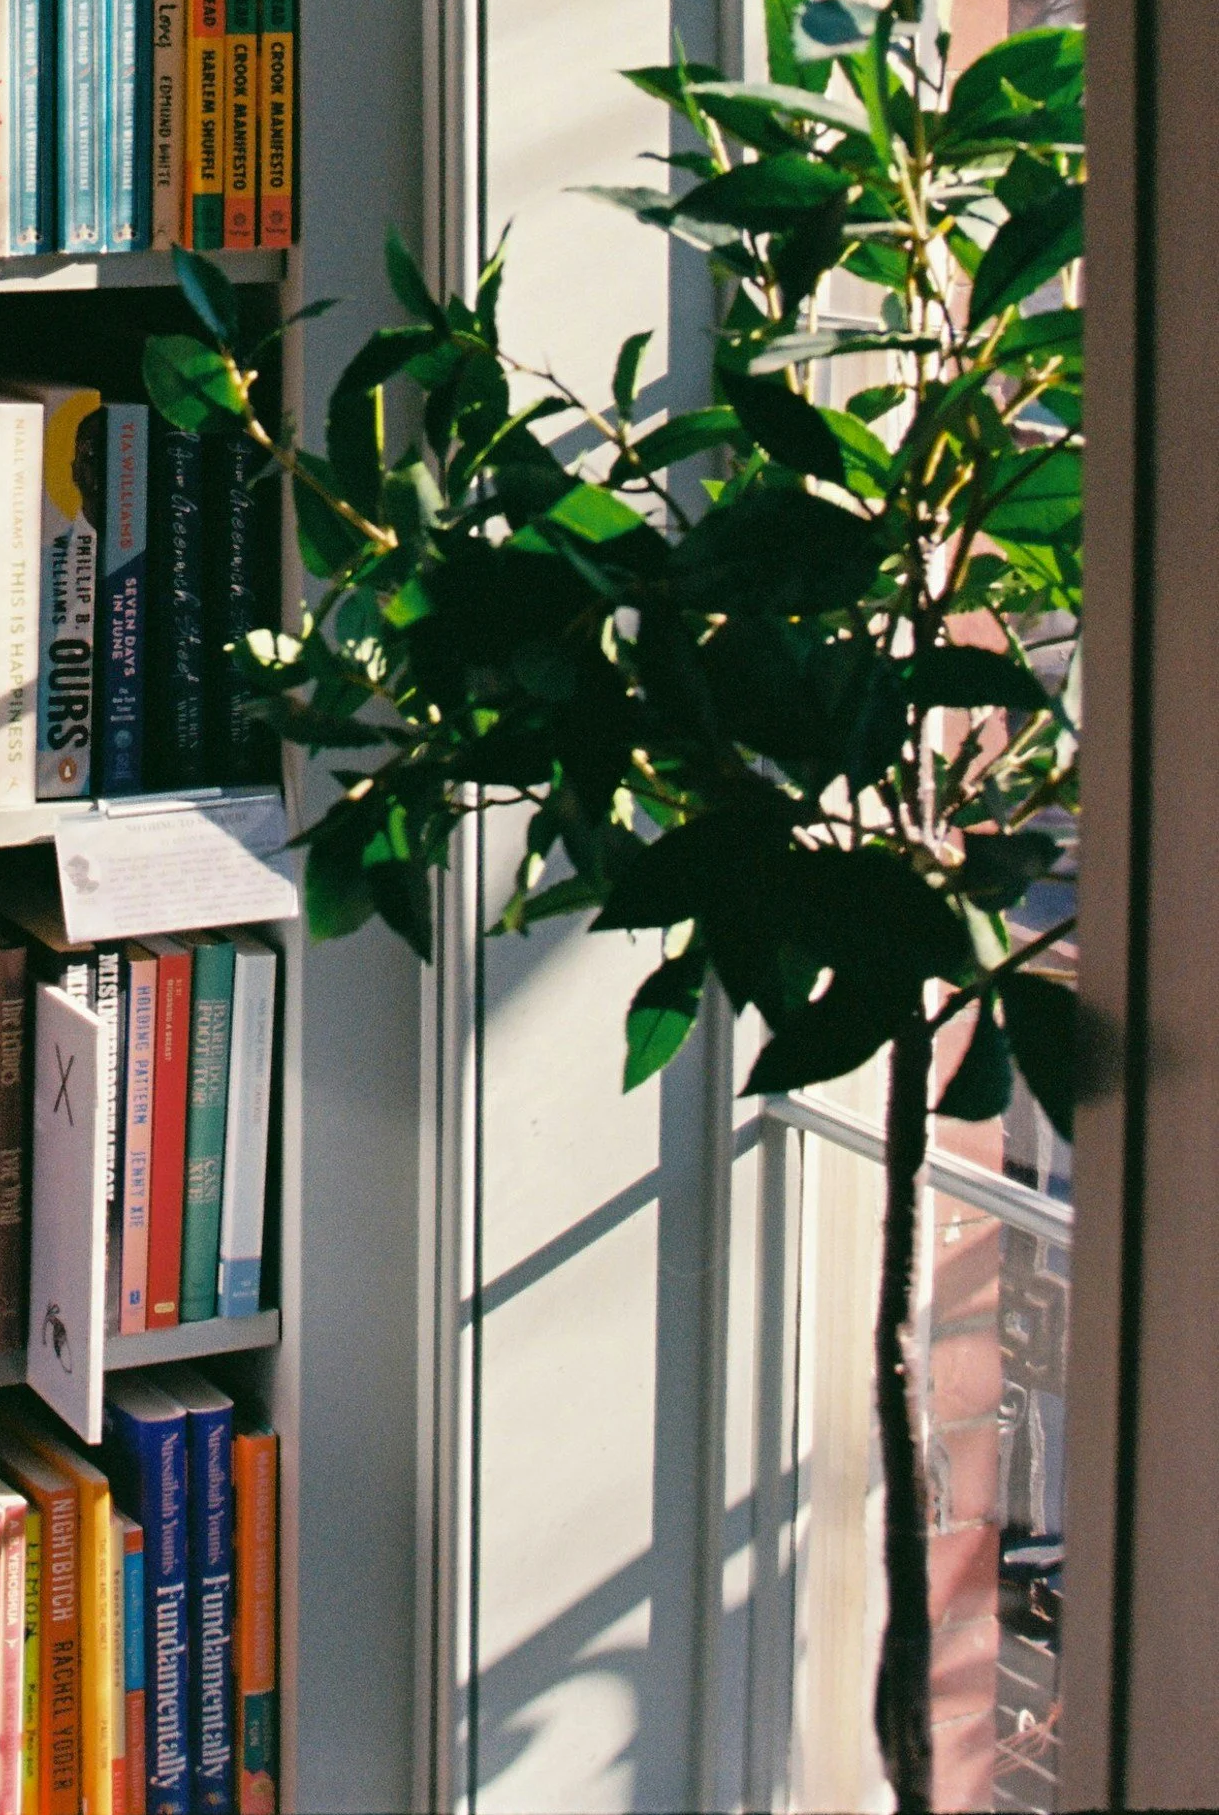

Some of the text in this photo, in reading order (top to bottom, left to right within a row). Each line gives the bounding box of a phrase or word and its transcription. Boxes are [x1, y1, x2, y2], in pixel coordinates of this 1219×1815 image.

[200, 50, 217, 114] HARLEM
[201, 119, 217, 180] SHUFFLE
[52, 536, 67, 625] WILLIAMS
[74, 536, 92, 630] PHILLIP B.
[111, 594, 123, 659] IN JUNE
[124, 578, 136, 677] SEVEN DAYS
[47, 639, 90, 751] OURS
[130, 985, 150, 1228] HOLDING PATTERN JENNY XIE
[52, 1499, 74, 1791] NIGHTBITCH RACHEL YODER
[198, 1573, 229, 1779] Fundamentally
